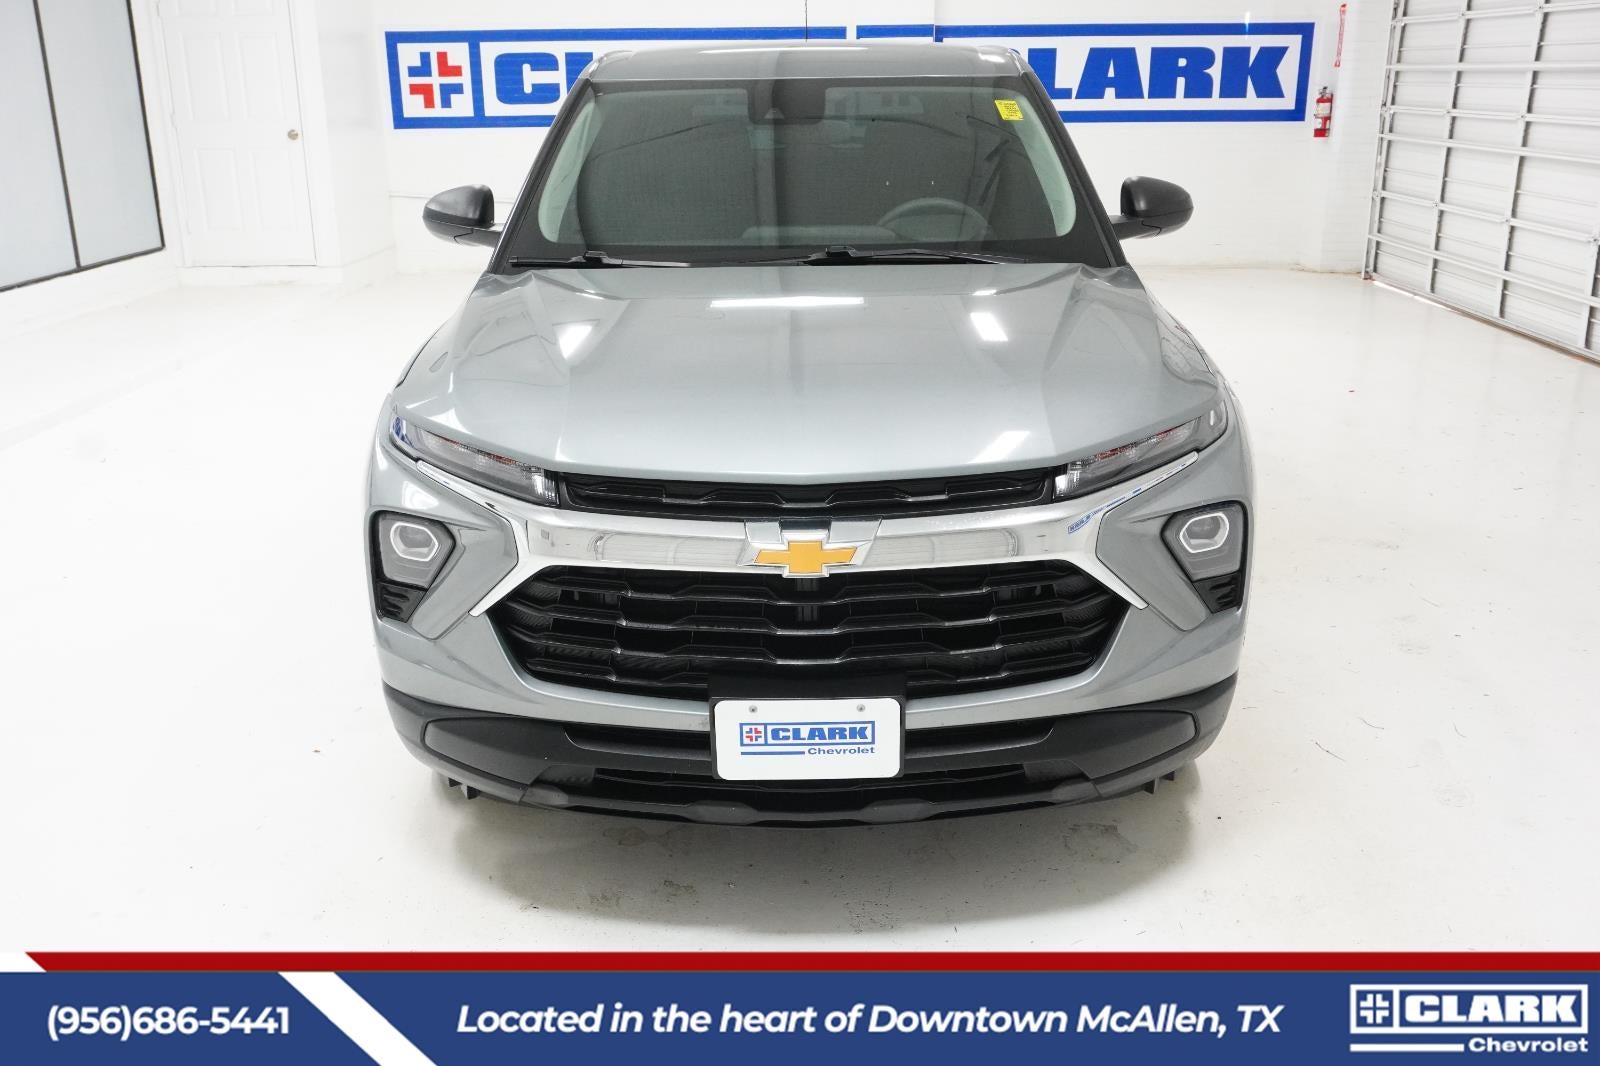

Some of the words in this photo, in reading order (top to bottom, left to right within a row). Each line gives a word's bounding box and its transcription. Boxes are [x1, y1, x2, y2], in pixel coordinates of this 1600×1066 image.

[1009, 47, 1287, 100] LARK
[770, 726, 868, 741] CLARK
[807, 746, 875, 755] Chevrolet
